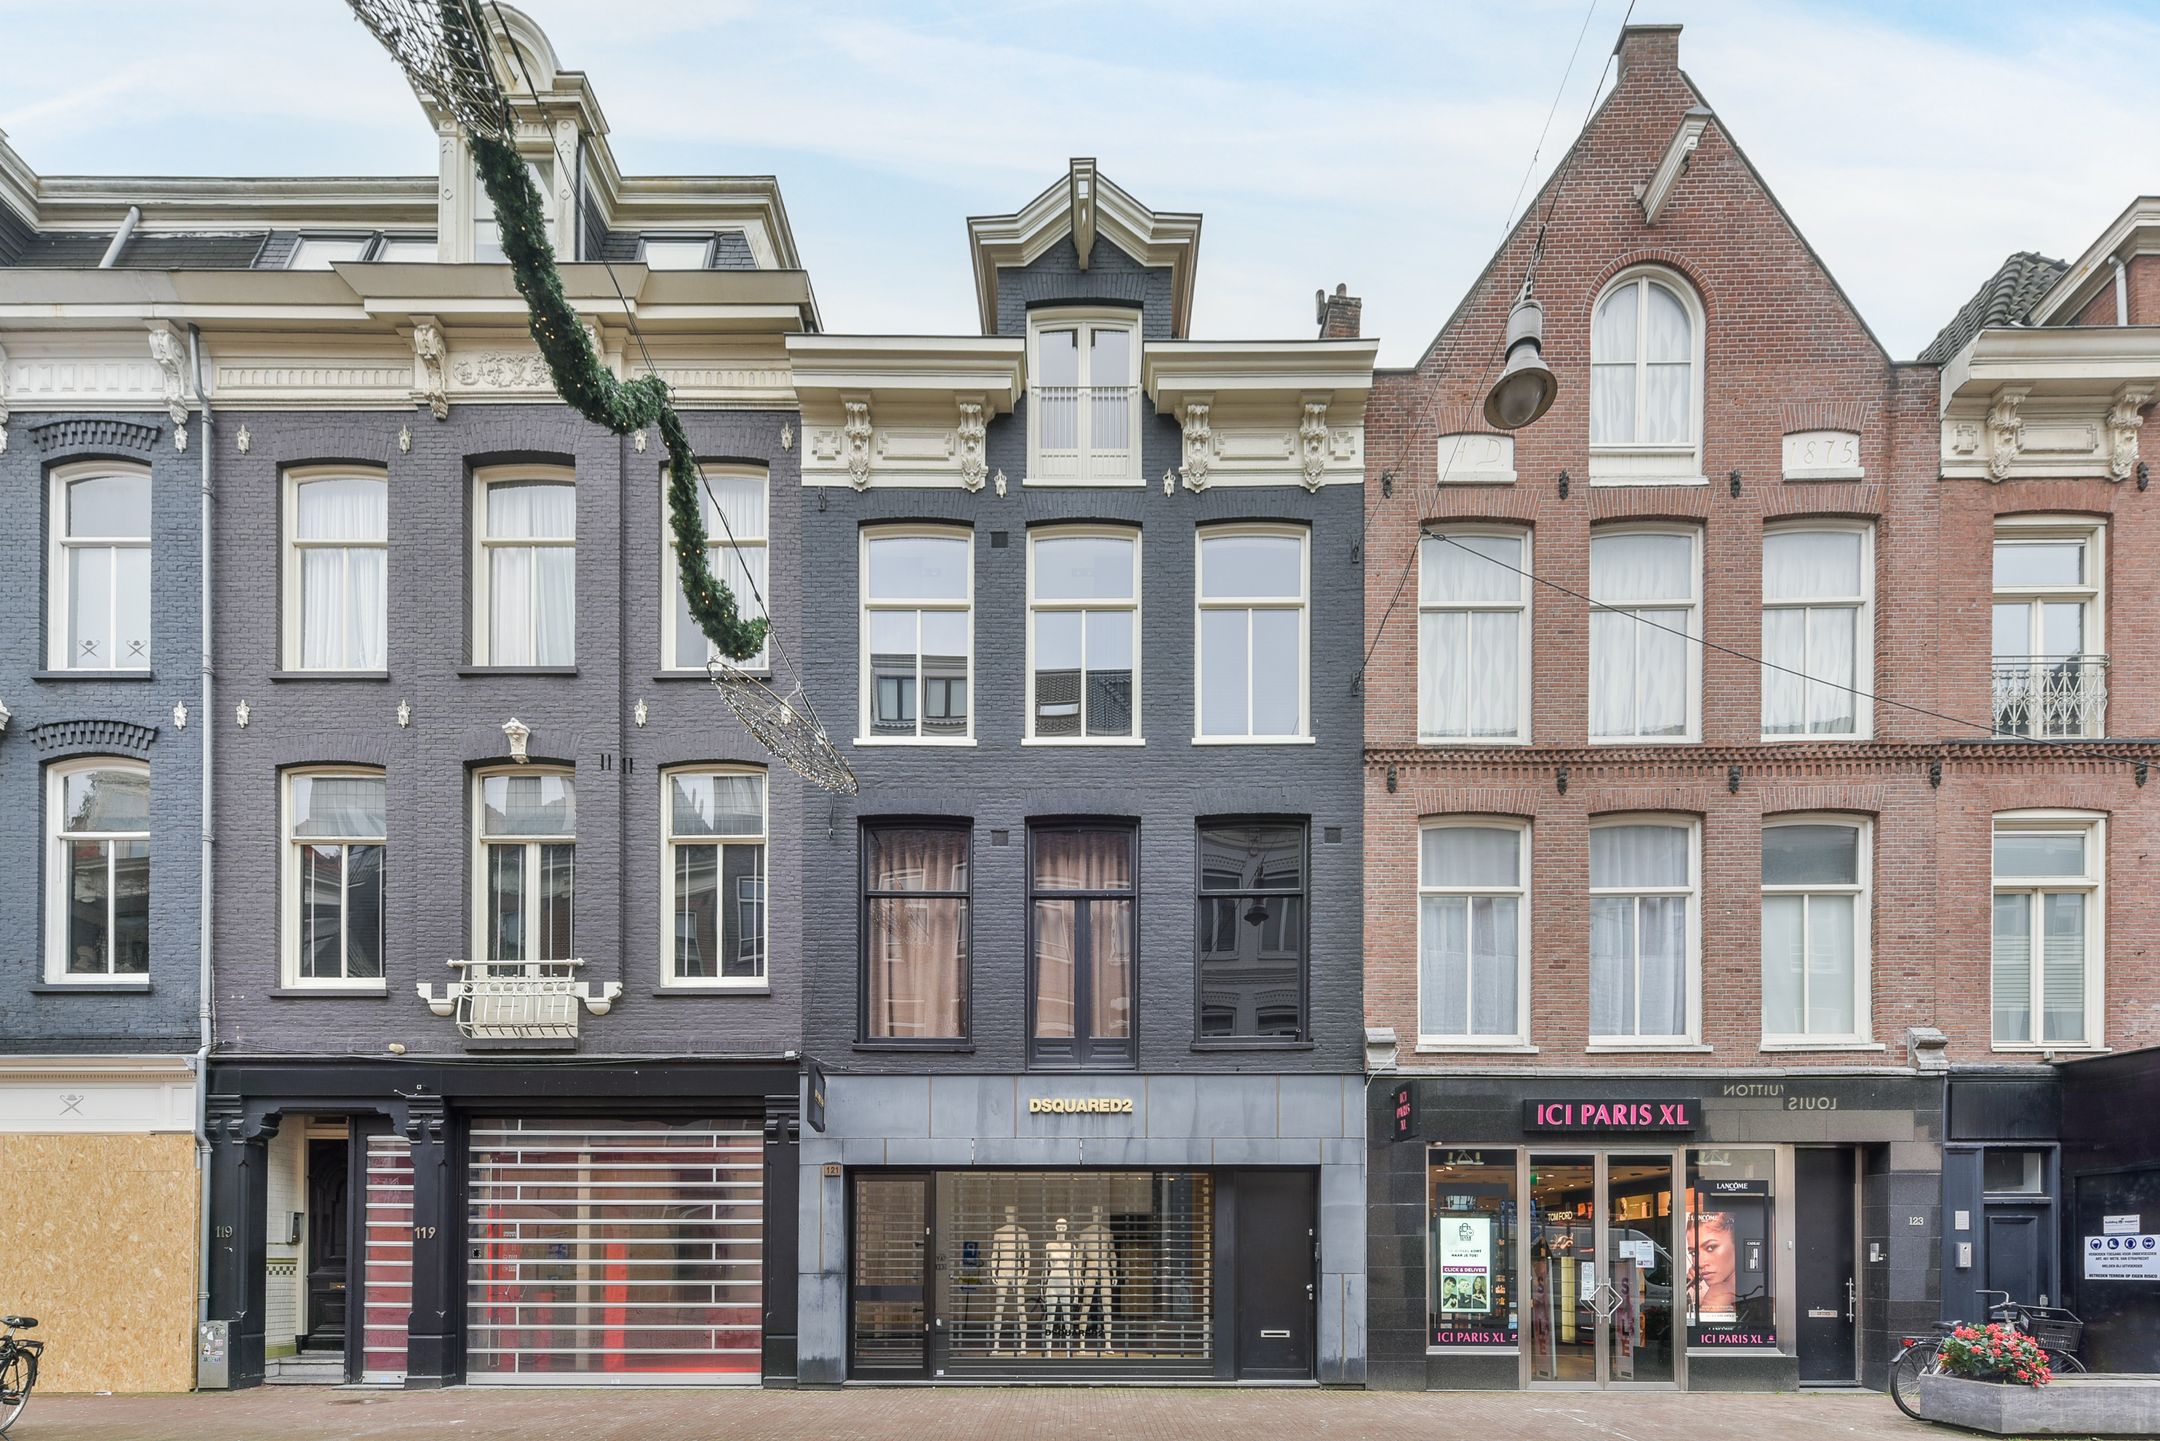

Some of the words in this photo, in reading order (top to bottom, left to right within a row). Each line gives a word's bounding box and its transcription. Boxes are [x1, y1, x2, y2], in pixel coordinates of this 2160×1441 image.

[1029, 1098, 1133, 1113] DSQUARED2
[1537, 1104, 1572, 1125] ICI
[1581, 1104, 1653, 1126] PARIS
[1659, 1104, 1689, 1125] XL
[826, 1166, 839, 1174] 121
[1547, 1213, 1558, 1221] TOM
[1559, 1211, 1572, 1220] FORD
[1909, 1216, 1924, 1226] 123
[215, 1225, 233, 1238] 119
[414, 1227, 436, 1239] 119
[1437, 1332, 1453, 1342] ICI
[1457, 1332, 1489, 1342] PARIS
[1492, 1332, 1506, 1342] XL
[1701, 1334, 1715, 1344] ICI
[1719, 1334, 1748, 1344] PARIS
[1750, 1334, 1763, 1344] XL
